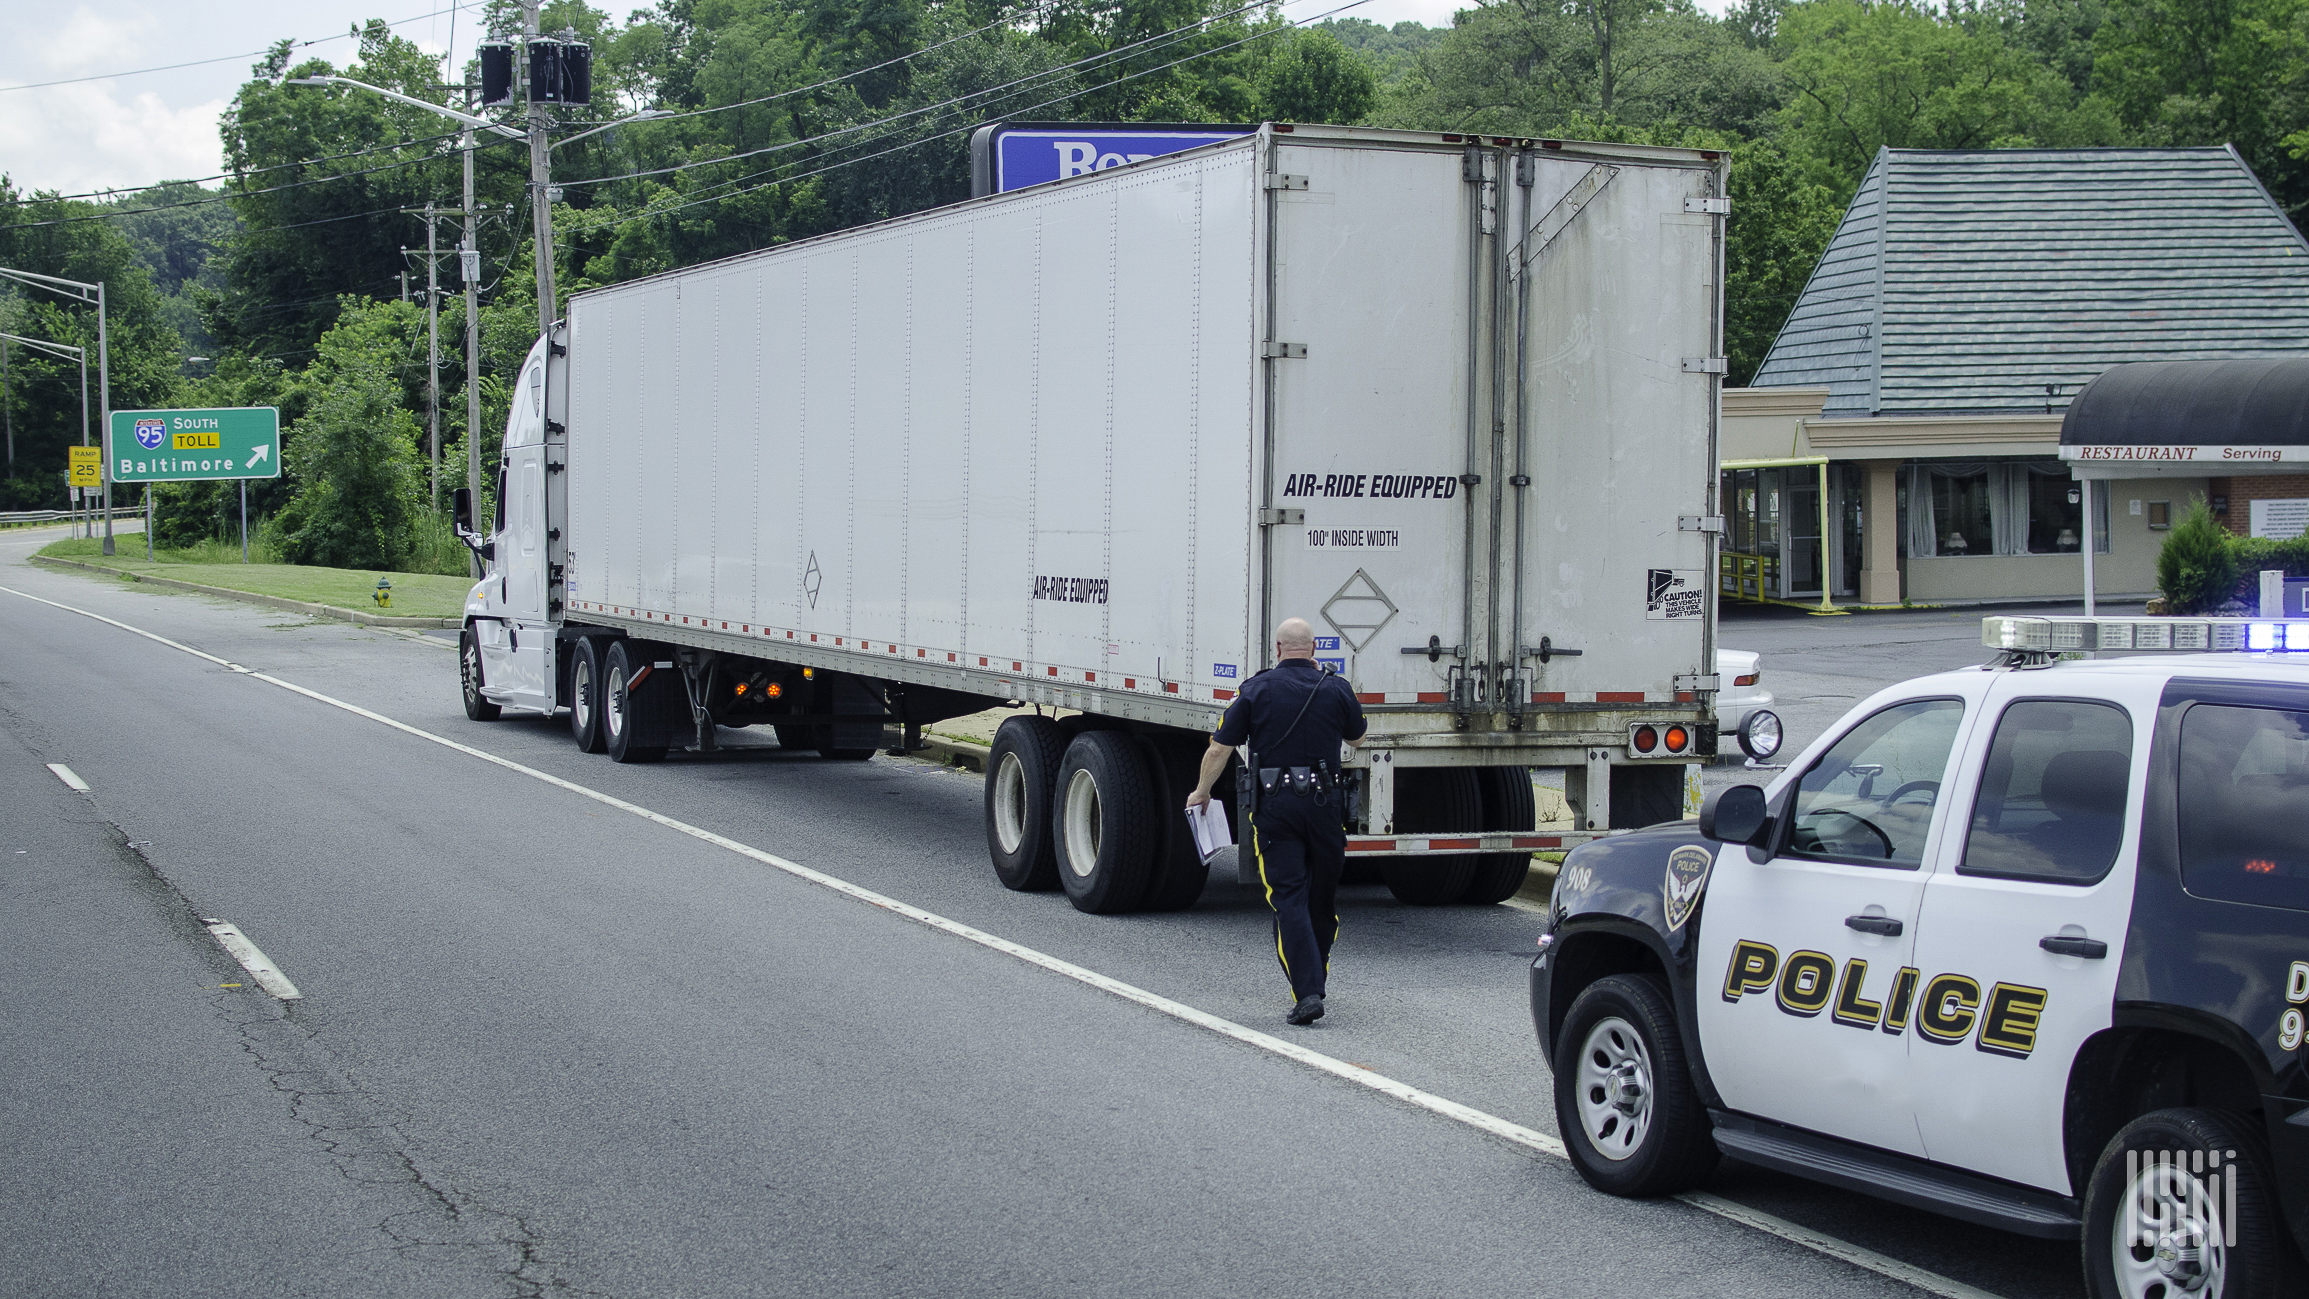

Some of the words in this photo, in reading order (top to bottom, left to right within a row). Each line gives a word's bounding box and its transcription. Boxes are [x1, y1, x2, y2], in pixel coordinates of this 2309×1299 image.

[138, 427, 163, 444] 95
[177, 435, 216, 447] TOLL
[2080, 446, 2198, 460] RESTAURANT
[2222, 447, 2283, 462] Serving
[76, 464, 95, 476] 25
[120, 457, 235, 474] Baltimore
[1282, 473, 1367, 498] AIR-RIDE
[1369, 474, 1457, 499] EQUIPPED
[1307, 530, 1330, 547] 100"
[1331, 530, 1364, 547] INSIDE
[1366, 530, 1399, 547] WIDTH
[1033, 575, 1069, 602] AIR-RIDE
[1069, 577, 1109, 604] EQUIPPED
[1664, 589, 1702, 601] CAUTION!
[1214, 665, 1235, 677] Z-PLATE
[1677, 860, 1700, 872] POLICE
[1566, 865, 1593, 892] 908
[2285, 960, 2309, 1004] D
[1722, 939, 2048, 1060] POLICE
